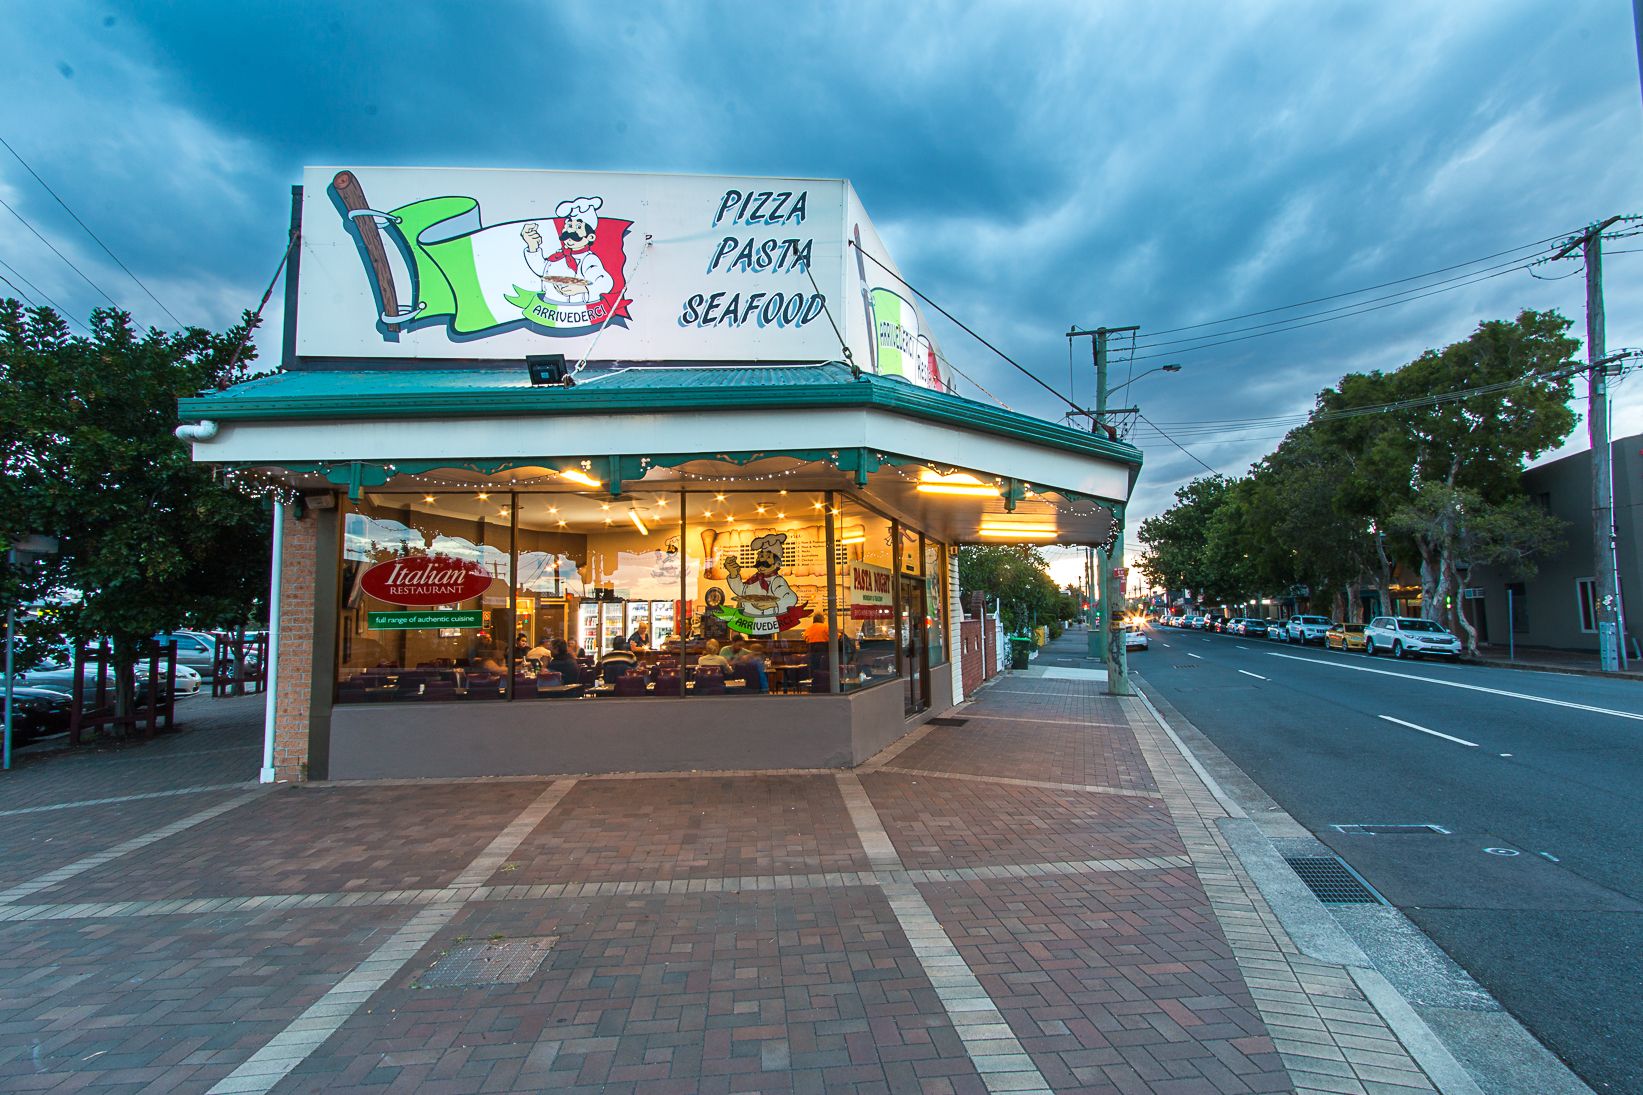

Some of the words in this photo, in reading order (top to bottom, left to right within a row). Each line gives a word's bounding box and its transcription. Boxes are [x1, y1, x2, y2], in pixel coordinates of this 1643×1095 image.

[713, 190, 807, 226] PIZZA
[708, 237, 813, 273] PASTA
[533, 304, 606, 323] ARRIVEDERCI
[679, 292, 826, 328] SEAFOOD
[385, 563, 466, 585] Italian
[853, 567, 872, 592] PASTA
[873, 571, 890, 594] NIGHT
[390, 585, 464, 595] RESTAURANT
[388, 617, 407, 625] range
[418, 615, 449, 623] authentic
